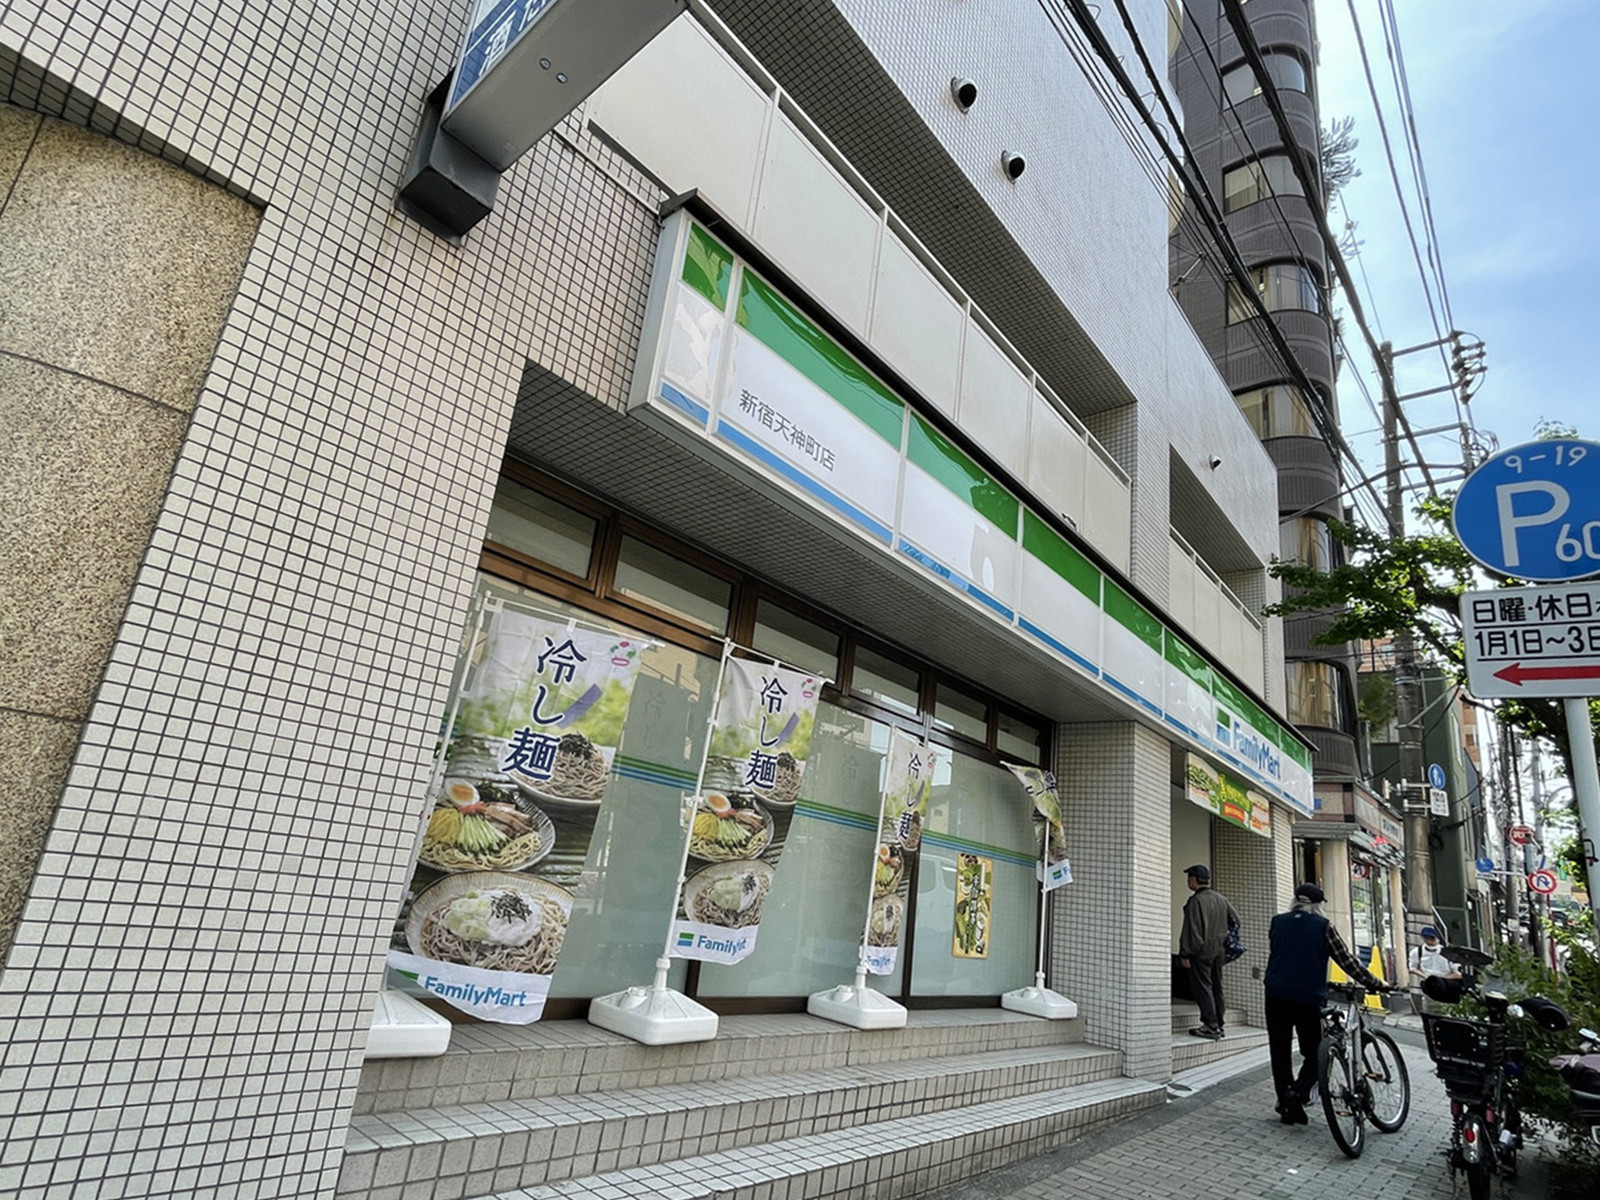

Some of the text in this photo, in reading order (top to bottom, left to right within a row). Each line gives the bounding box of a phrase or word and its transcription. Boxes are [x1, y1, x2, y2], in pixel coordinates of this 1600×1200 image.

[739, 389, 836, 472] 新宿天神町店
[1504, 445, 1588, 474] 9-19
[1496, 480, 1570, 567] P
[1473, 593, 1600, 624] 日曜・休日
[501, 636, 588, 781] 冷し麺
[745, 676, 788, 790] 冷し麺
[424, 976, 527, 1008] FamilyMart
